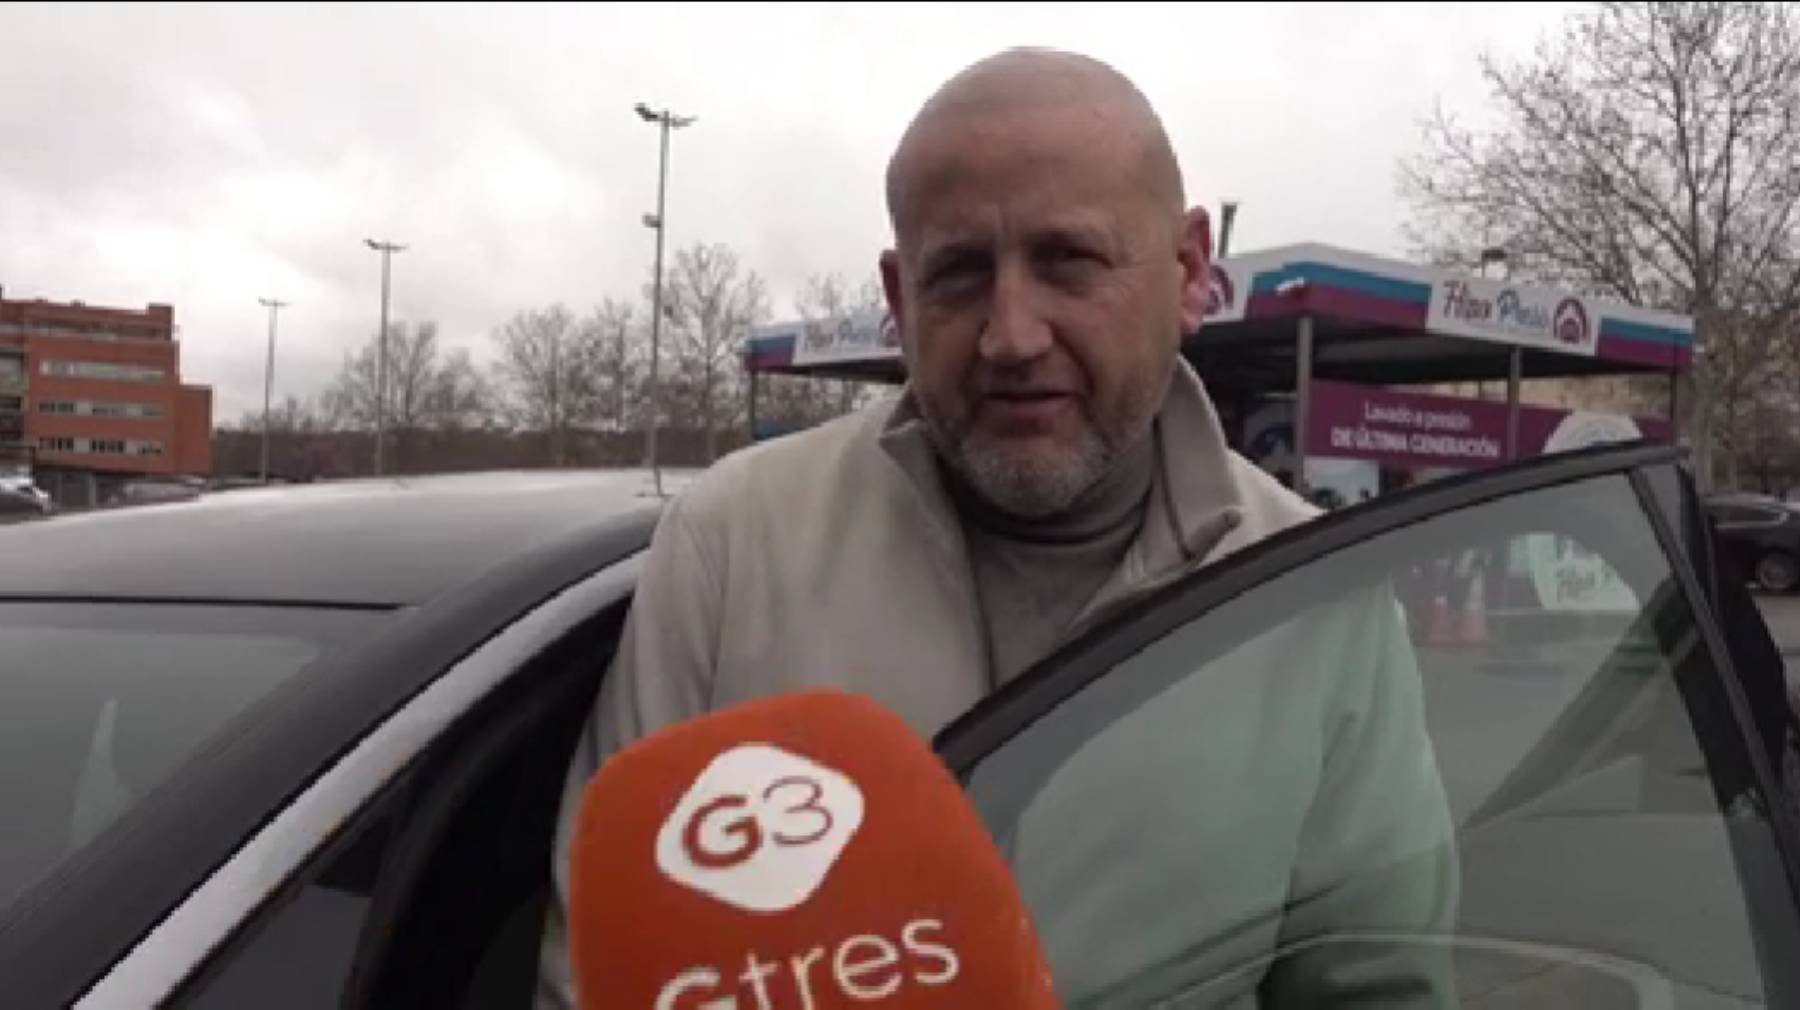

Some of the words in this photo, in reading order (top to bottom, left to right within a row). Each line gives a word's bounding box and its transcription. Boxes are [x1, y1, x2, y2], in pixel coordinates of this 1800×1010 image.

[1364, 401, 1411, 423] Lavado
[1331, 426, 1352, 447] DE
[1355, 423, 1407, 451] ÚLTIMA
[1410, 432, 1498, 458] GENERACIÓN
[682, 774, 833, 869] G3
